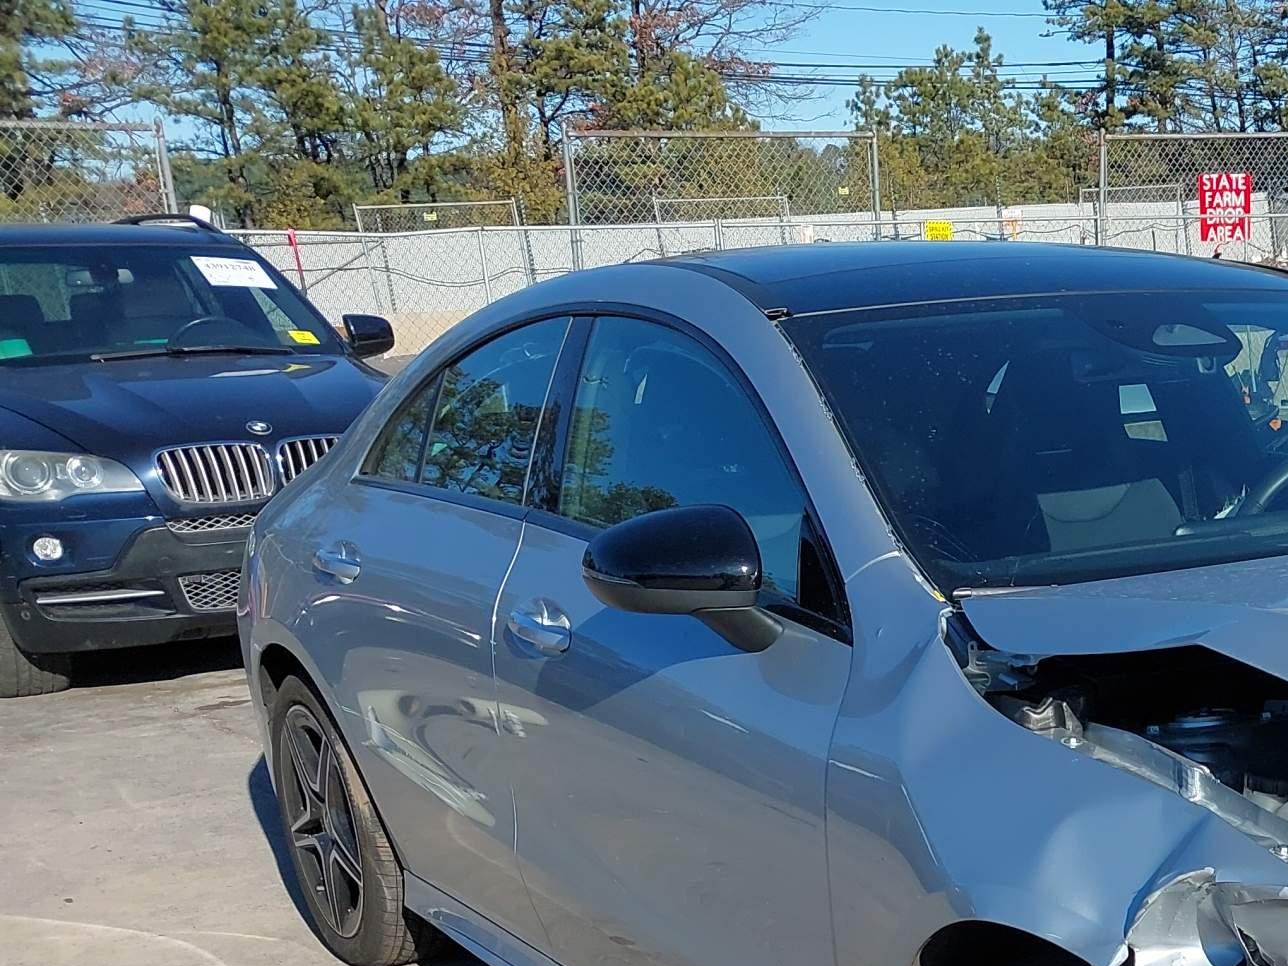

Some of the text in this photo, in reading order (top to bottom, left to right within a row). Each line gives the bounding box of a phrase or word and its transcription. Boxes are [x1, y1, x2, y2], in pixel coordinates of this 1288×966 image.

[1202, 174, 1247, 190] STATE
[1205, 191, 1245, 207] FARM
[1206, 208, 1244, 225] DROP
[1207, 226, 1244, 241] AREA
